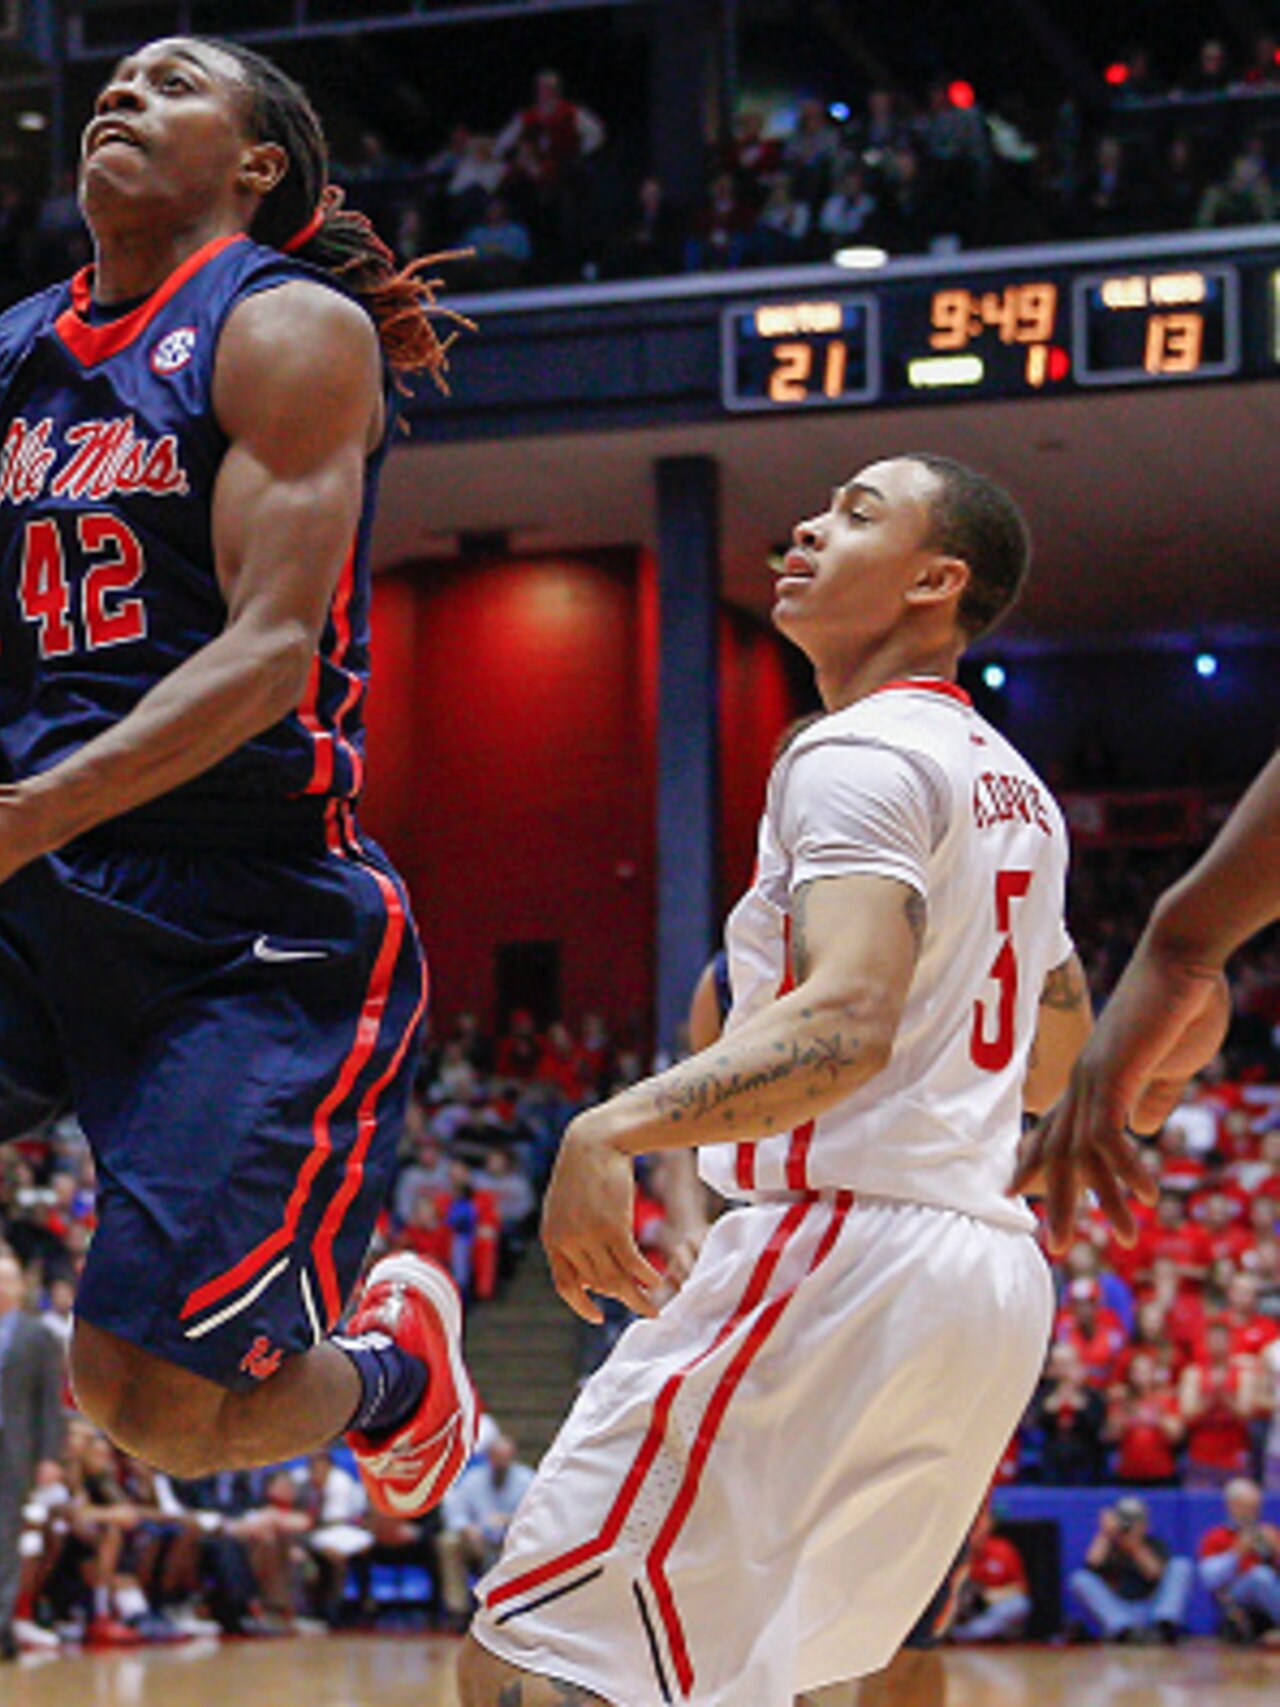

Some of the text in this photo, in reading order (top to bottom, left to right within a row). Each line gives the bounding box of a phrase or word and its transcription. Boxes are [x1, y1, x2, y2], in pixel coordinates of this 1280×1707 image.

[929, 282, 1057, 350] 9:49
[1144, 313, 1205, 375] 13
[769, 341, 847, 402] 21
[18, 512, 148, 660] 42
